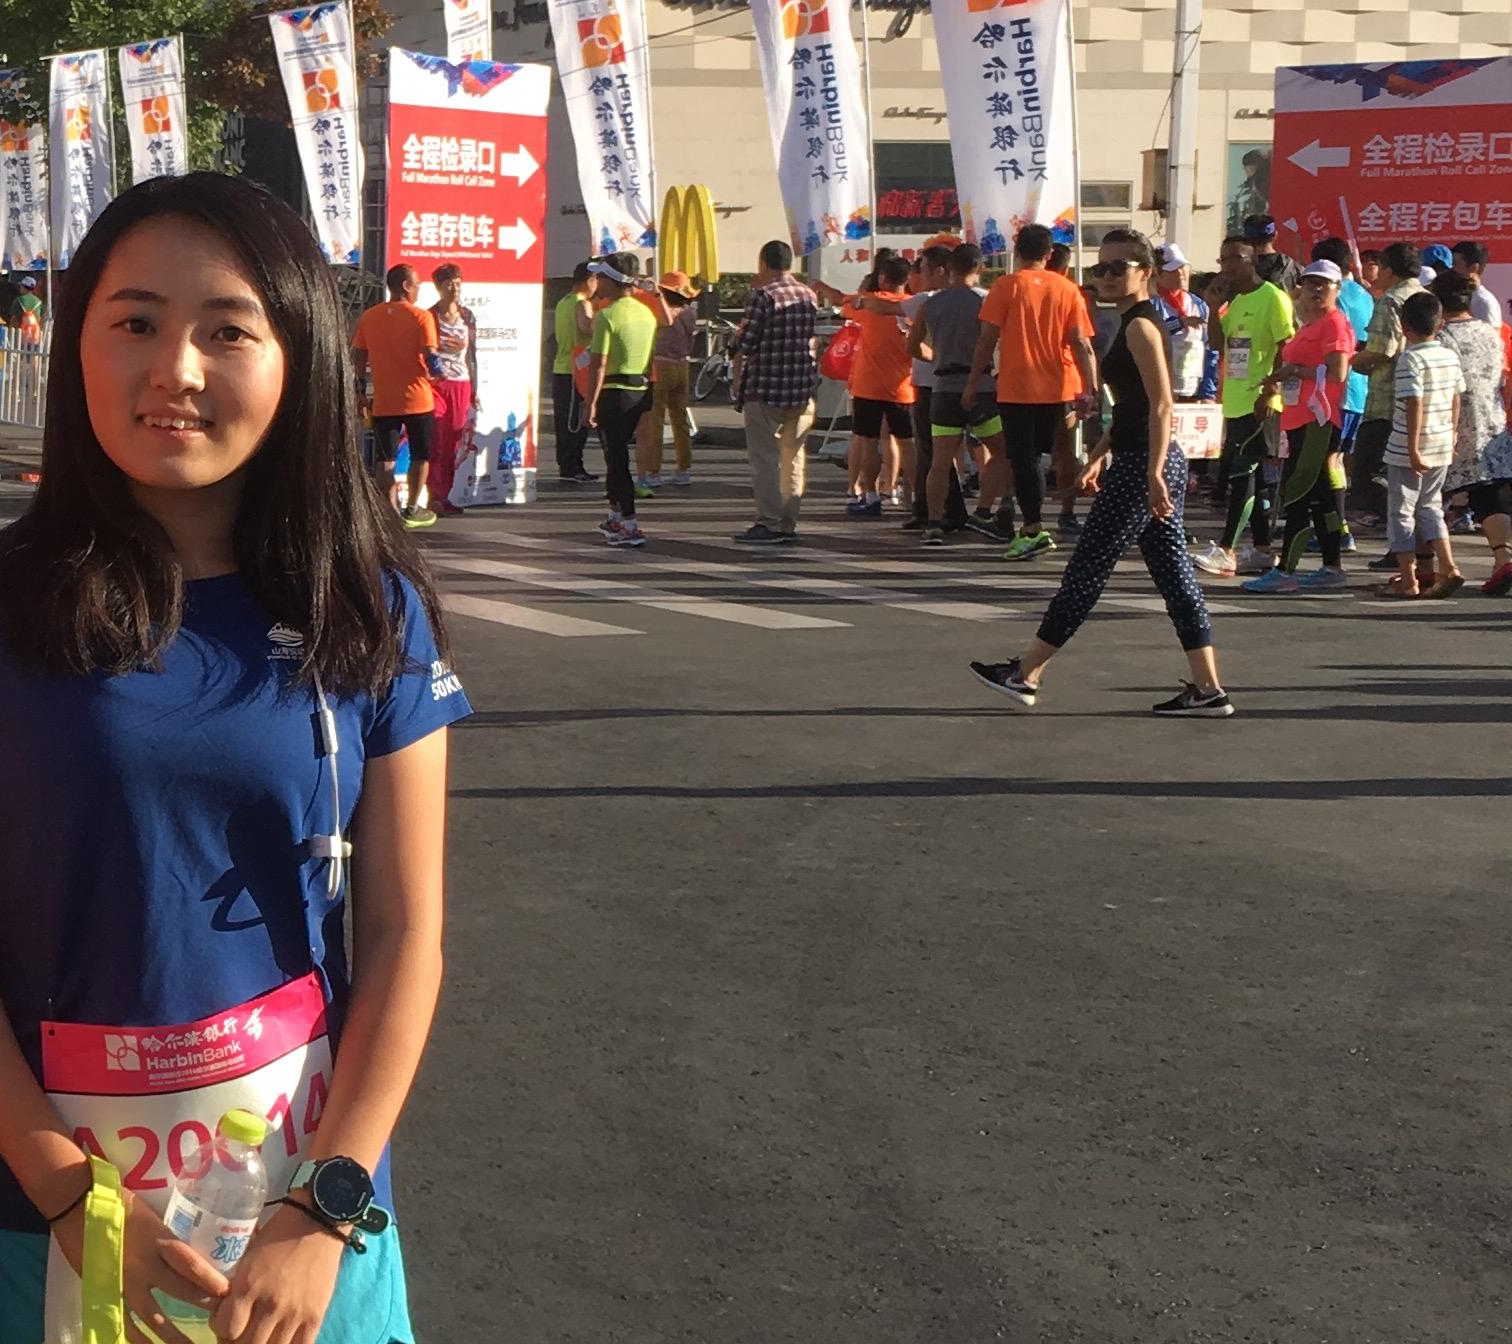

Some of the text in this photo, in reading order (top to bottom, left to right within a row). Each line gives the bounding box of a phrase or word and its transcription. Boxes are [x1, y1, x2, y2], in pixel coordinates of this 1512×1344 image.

[402, 133, 496, 174] 全程检录口
[1362, 131, 1512, 166] 全程检录口
[1360, 168, 1380, 177] Full
[1383, 166, 1437, 177] Marathon
[1441, 165, 1462, 175] Roll
[1465, 165, 1486, 175] Call
[400, 211, 494, 249] 全程存包车
[1357, 200, 1512, 232] 全程存包车
[147, 1040, 242, 1070] HarbinBank
